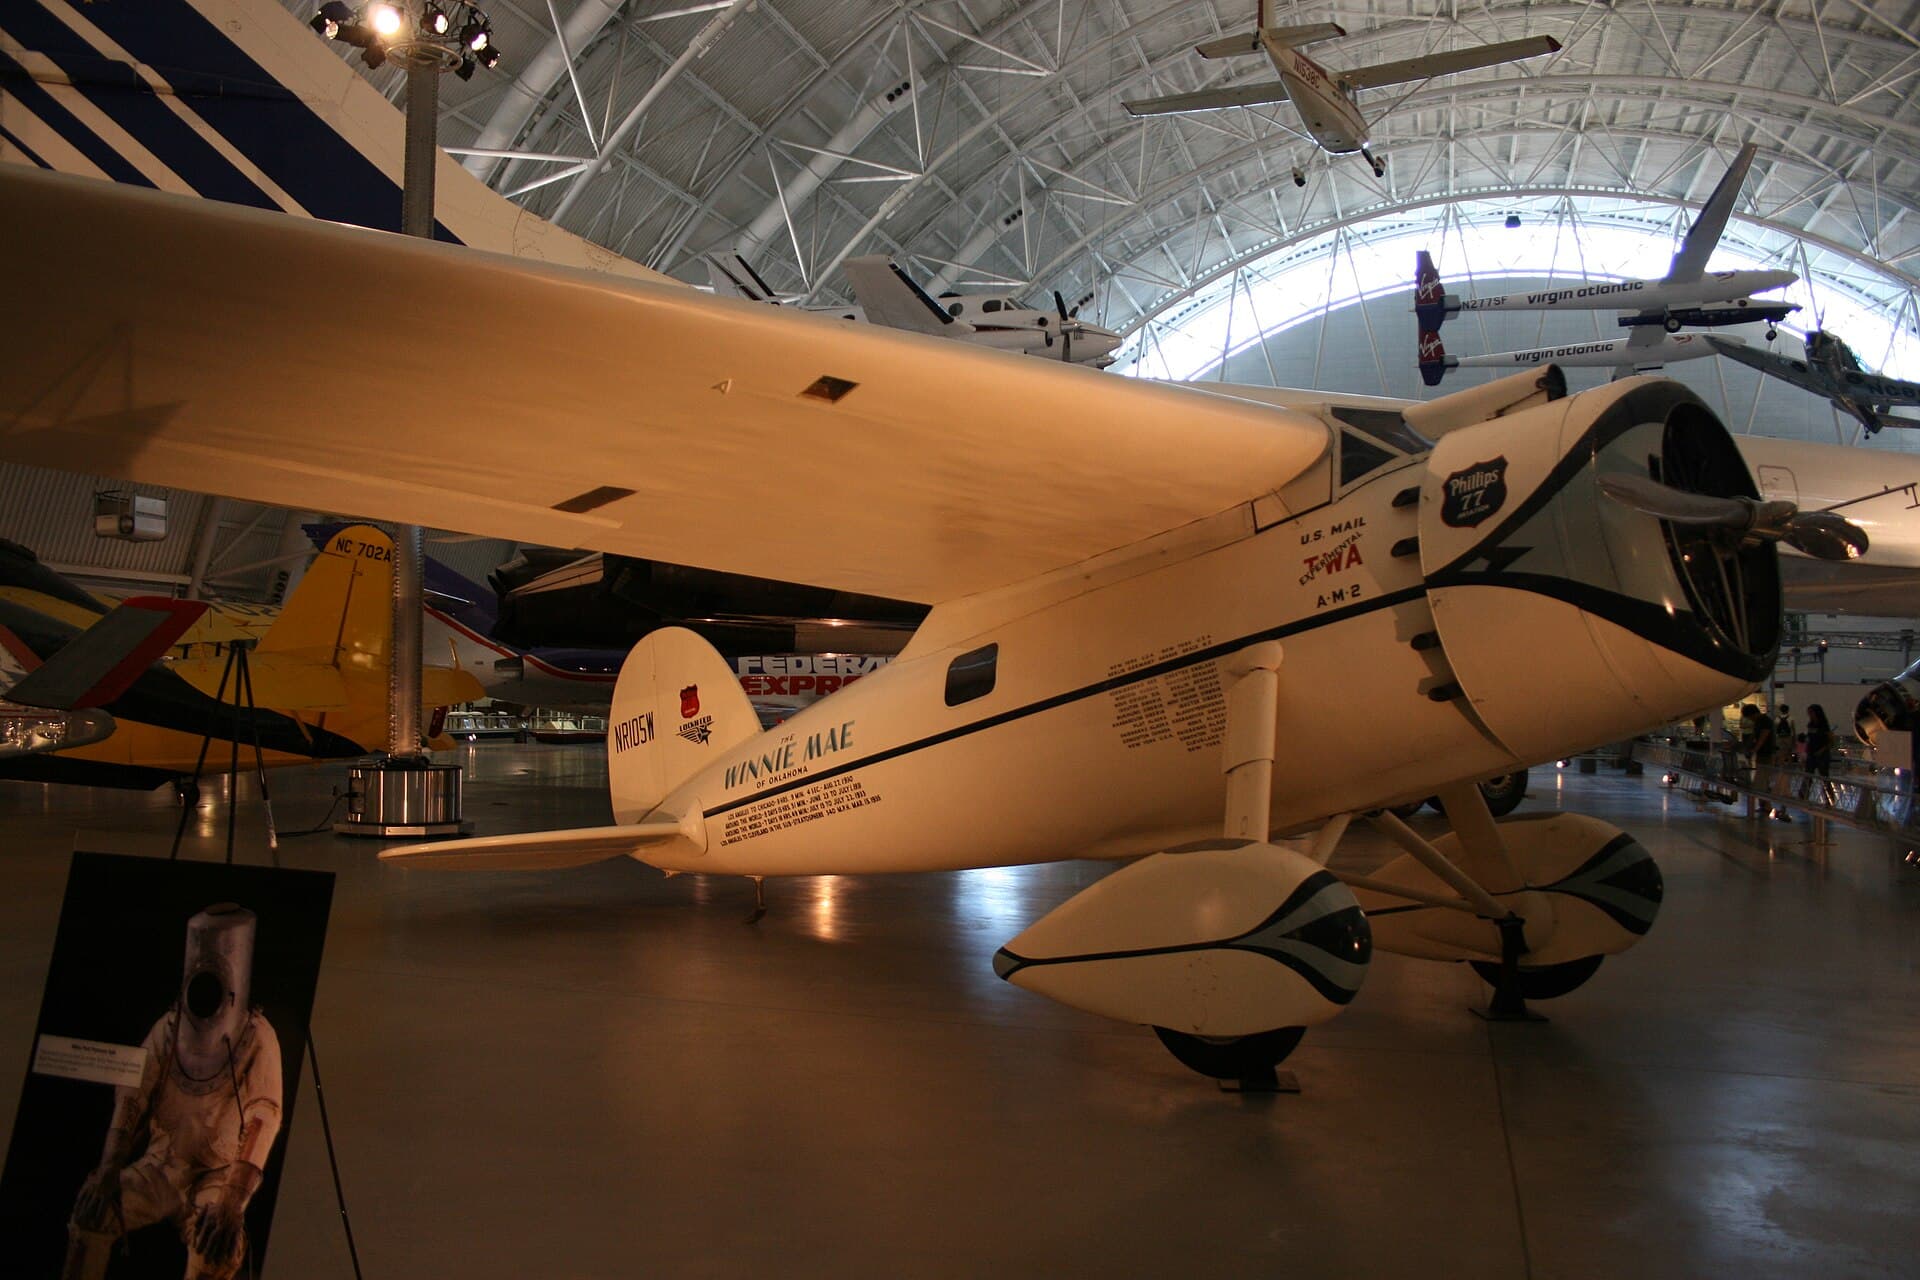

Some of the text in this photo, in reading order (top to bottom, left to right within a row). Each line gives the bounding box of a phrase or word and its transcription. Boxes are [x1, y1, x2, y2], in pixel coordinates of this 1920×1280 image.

[1418, 273, 1440, 300] Virgin
[1527, 280, 1644, 305] virgin atlantic
[1462, 296, 1508, 310] N277SF
[1514, 343, 1614, 362] virgin atlantic
[1450, 470, 1500, 496] Phillips
[1461, 489, 1486, 510] 77
[1301, 517, 1366, 545] U.S. MAIL
[336, 537, 391, 562] NC 702A
[1299, 532, 1362, 586] EXPERIMENTAL
[1304, 544, 1363, 580] TWA
[738, 656, 897, 674] FEDERA
[614, 711, 655, 754] NR105W
[680, 715, 712, 732] LOCKHEED
[780, 733, 796, 744] THE
[725, 721, 856, 790] WINNIE MAE
[756, 766, 808, 788] OF OKLAHOMA
